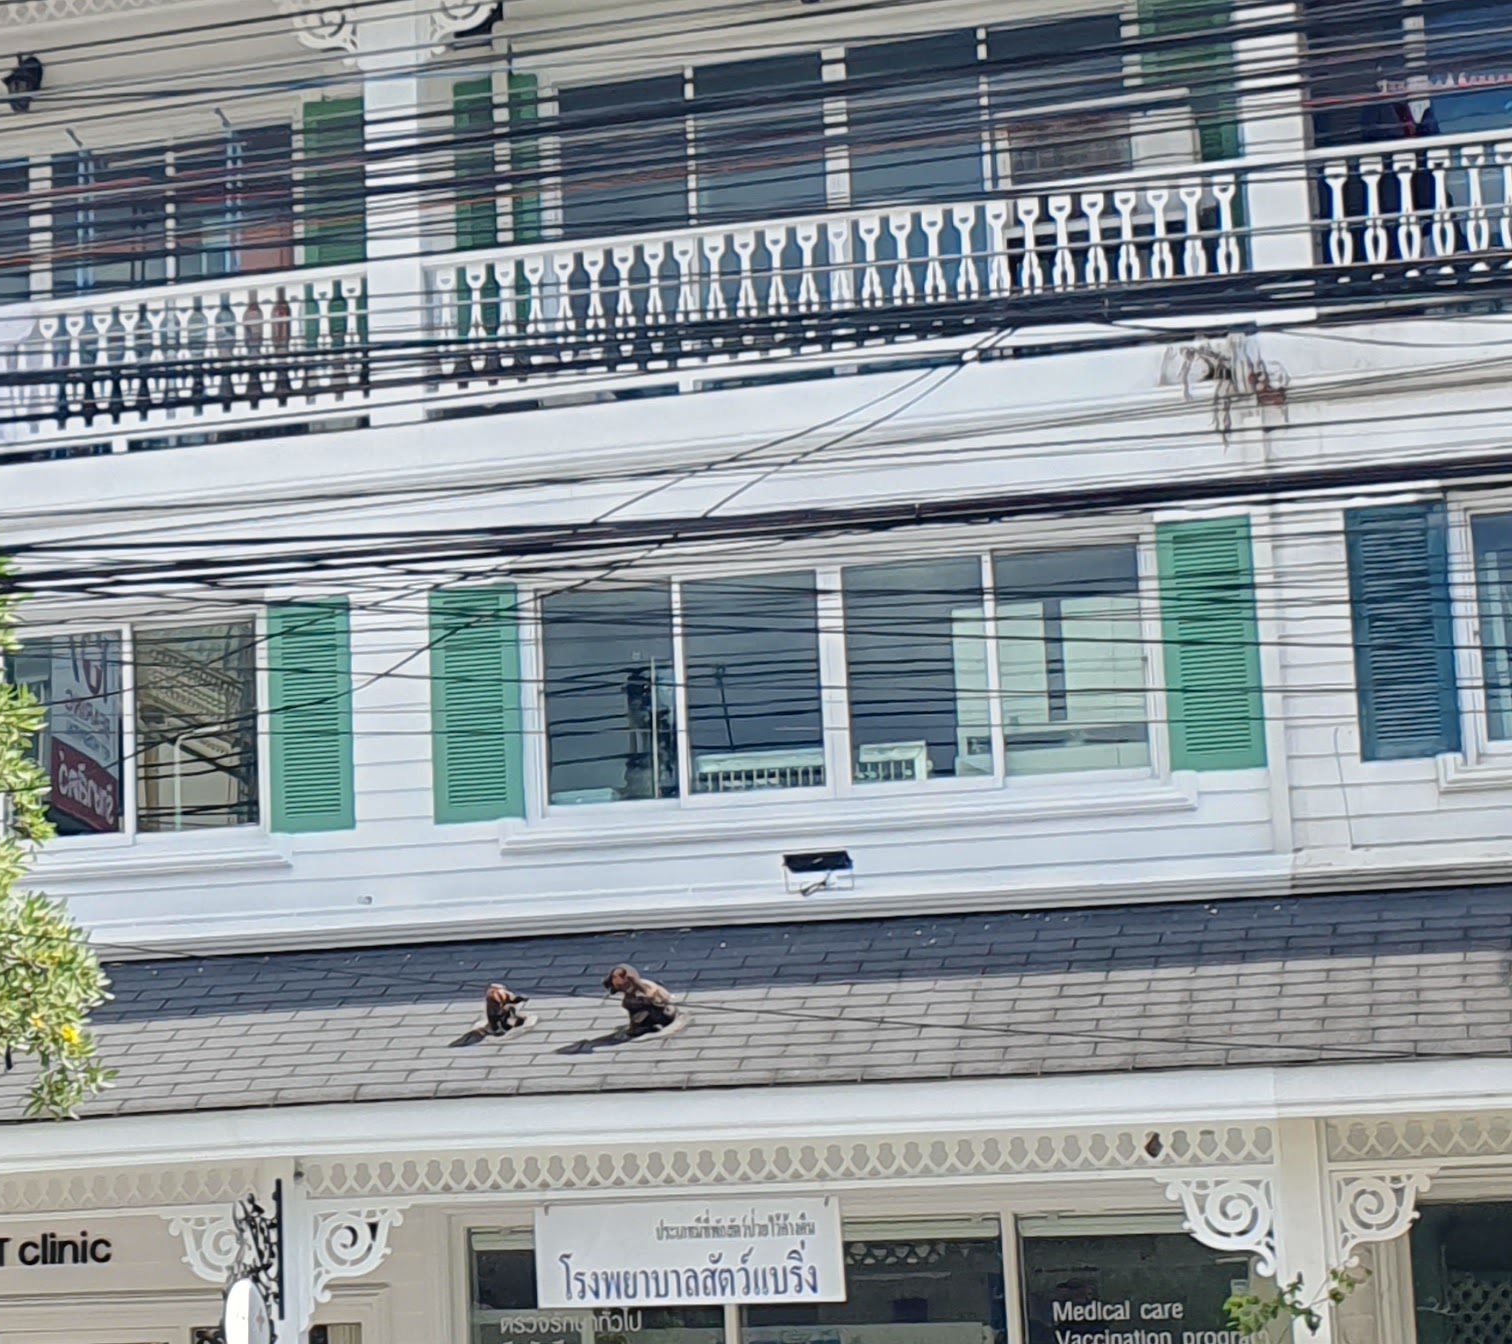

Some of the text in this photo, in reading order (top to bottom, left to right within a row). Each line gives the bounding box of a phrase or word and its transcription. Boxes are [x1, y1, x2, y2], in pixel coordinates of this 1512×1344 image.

[18, 1230, 112, 1267] clinic
[558, 1239, 819, 1301] โรงพยาบาลสัตว์แบริ่ง
[1052, 1299, 1184, 1322] Medical care
